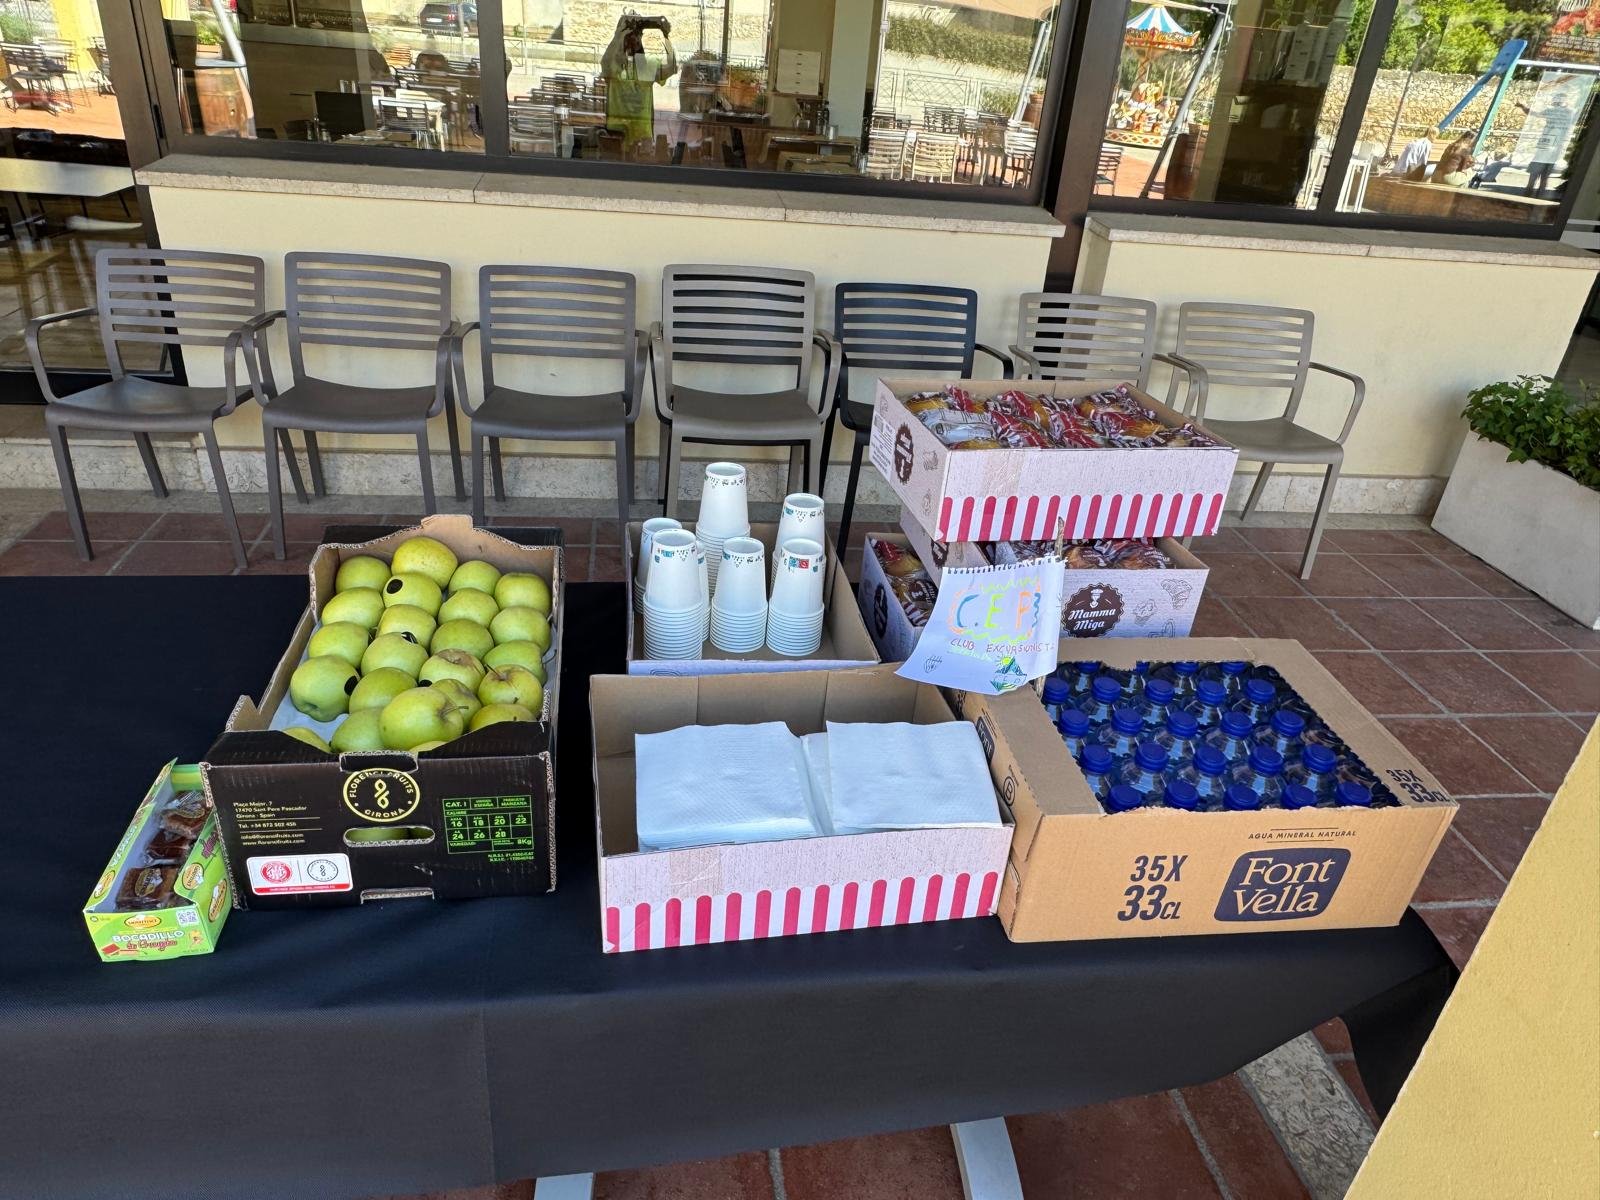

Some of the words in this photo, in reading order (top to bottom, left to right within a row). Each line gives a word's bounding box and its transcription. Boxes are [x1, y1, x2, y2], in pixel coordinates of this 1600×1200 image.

[1067, 608, 1117, 620] Mamma
[1073, 620, 1105, 631] Miga
[950, 638, 975, 651] CLUB
[1385, 769, 1424, 783] 35X
[1400, 782, 1451, 803] 33CL
[364, 808, 405, 818] GIRONA
[1276, 831, 1315, 839] MINERAL
[1317, 830, 1357, 838] NATURAL
[1130, 854, 1188, 882] 35X
[1238, 857, 1337, 886] Font
[1117, 884, 1182, 922] 33CL
[1233, 884, 1319, 915] Vella
[112, 930, 185, 942] BOCADILLO
